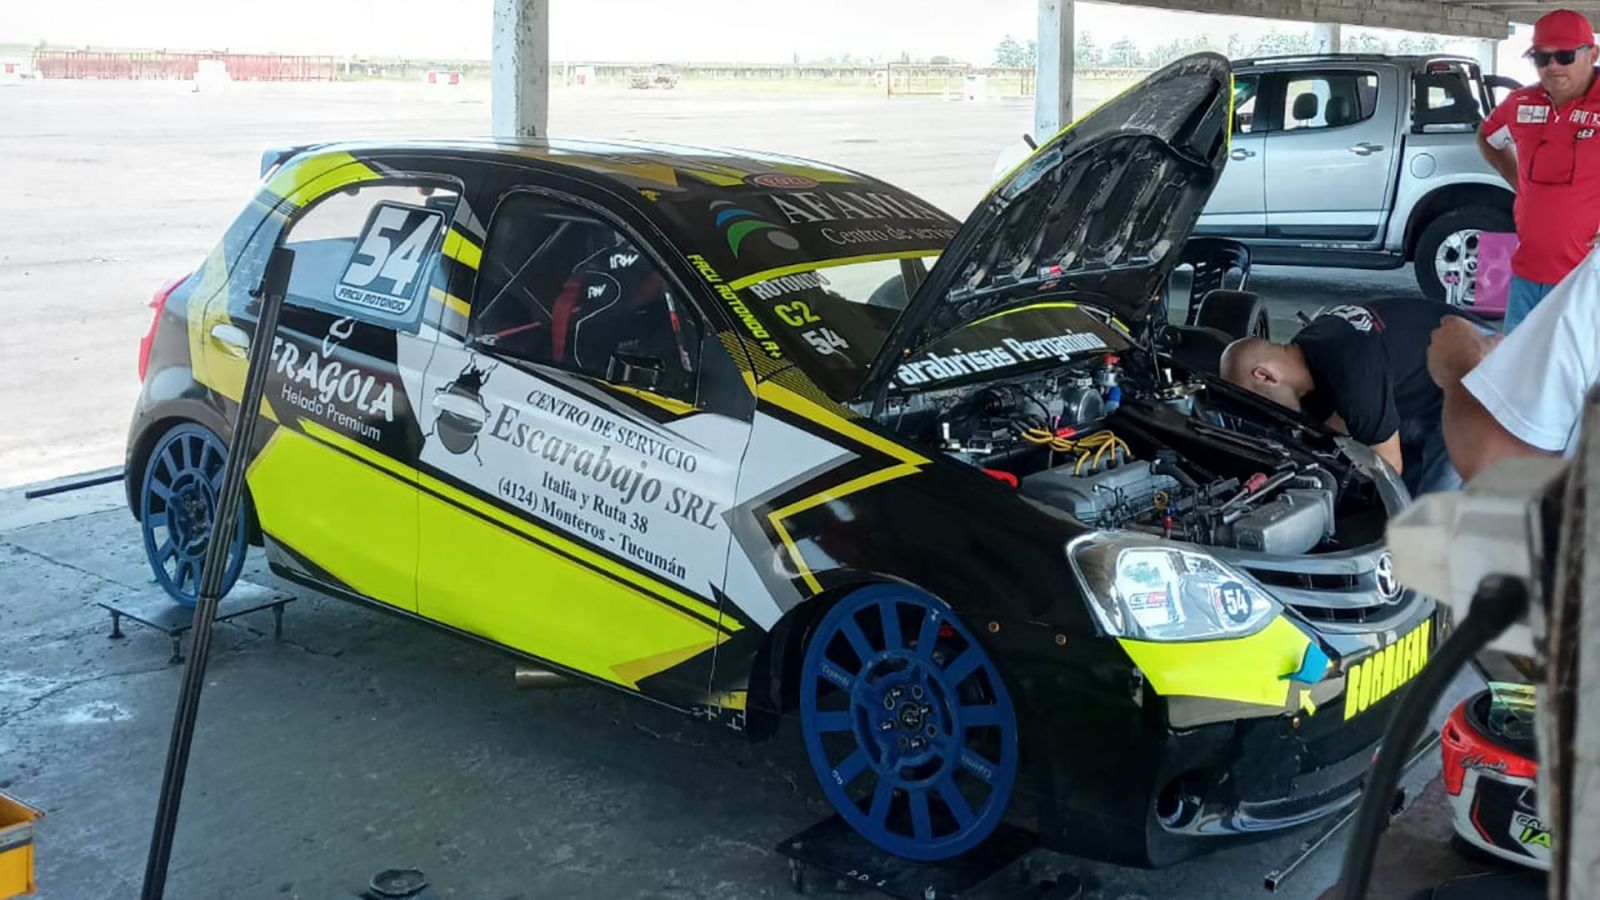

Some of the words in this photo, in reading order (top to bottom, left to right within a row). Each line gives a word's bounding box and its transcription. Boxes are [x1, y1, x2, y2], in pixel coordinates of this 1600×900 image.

[342, 206, 441, 296] 54
[820, 228, 888, 249] Centro
[338, 288, 363, 301] FACU
[362, 294, 406, 312] ROTONDO
[687, 253, 723, 283] FACU
[714, 284, 770, 339] ROTONDO
[749, 269, 831, 300] ROTONDO
[774, 301, 821, 327] C2
[802, 327, 849, 355] 54
[888, 347, 1017, 389] arabrisas
[1002, 328, 1107, 362] Pergamino
[281, 383, 323, 415] Helado
[326, 403, 381, 441] Premium
[526, 389, 590, 427] CENTRO
[590, 415, 616, 438] DE
[615, 426, 697, 473] SERVICIO
[488, 403, 662, 505] Escarabajo
[665, 487, 719, 531] SRL
[498, 476, 538, 511] (4124)
[542, 497, 606, 541] Monteros
[618, 532, 686, 580] Tucumán
[542, 471, 577, 501] Italia
[579, 494, 590, 510] y
[593, 495, 627, 525] Ruta
[630, 512, 649, 534] 38
[1223, 588, 1249, 615] 54
